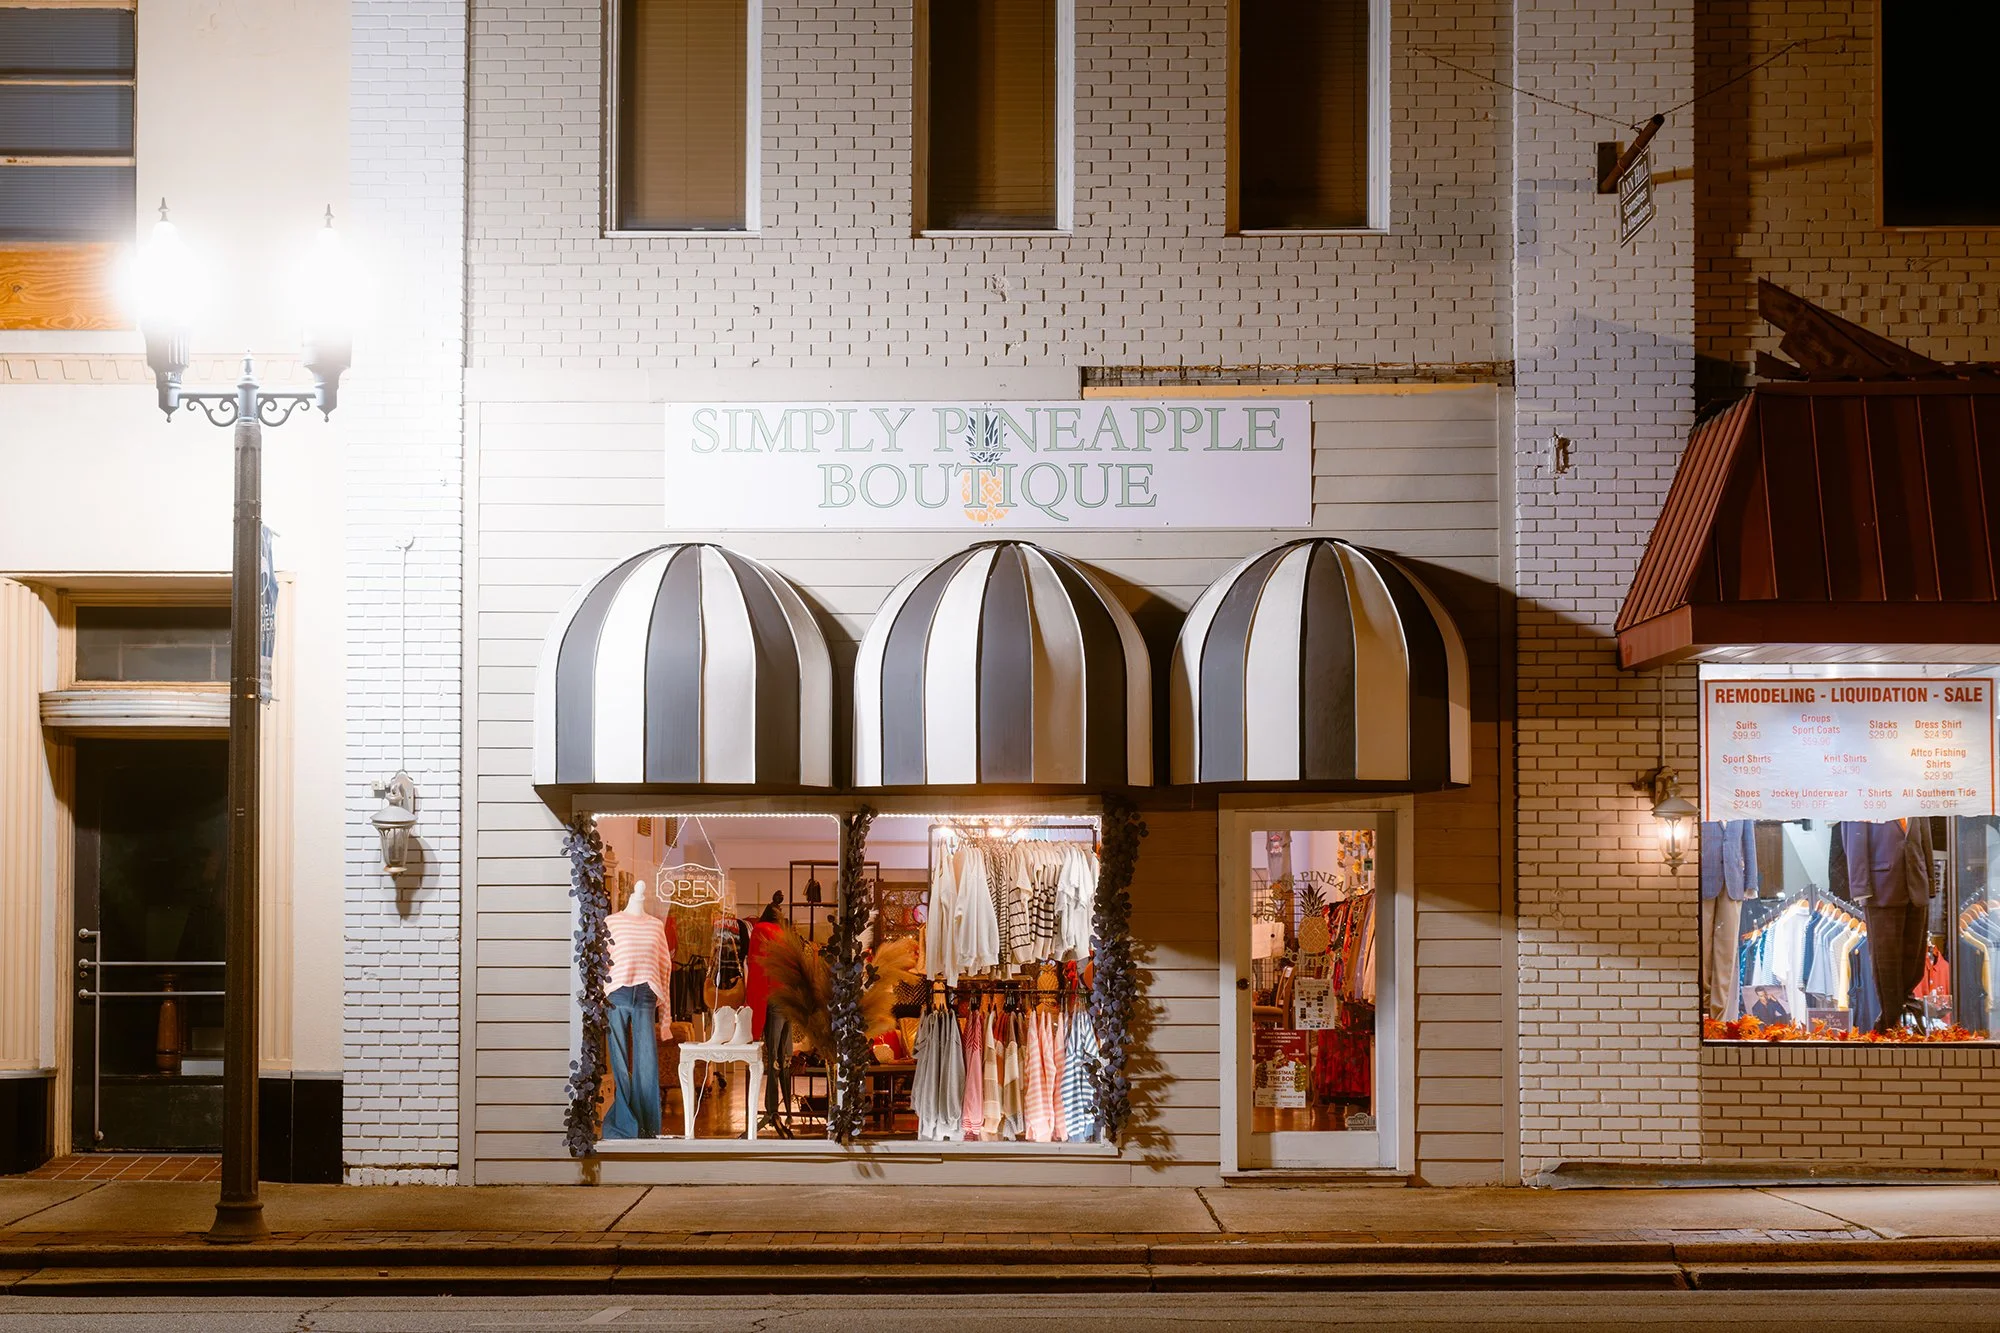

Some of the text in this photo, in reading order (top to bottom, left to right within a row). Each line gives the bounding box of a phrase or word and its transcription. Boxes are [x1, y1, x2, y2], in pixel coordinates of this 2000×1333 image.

[690, 405, 1285, 453] SIMPLY PINEAPPLE
[817, 462, 1158, 522] BOUTIQUE
[1715, 687, 1815, 703] REMODELING
[1831, 687, 1928, 704] LIQUIDATION
[1944, 686, 1983, 703] SALE
[1801, 713, 1831, 723] Groups
[1736, 720, 1758, 730] Suits
[1869, 720, 1898, 729] Slacks
[1915, 720, 1962, 729] Dress Shirt
[1792, 725, 1841, 736] Sport Coats
[1935, 748, 1966, 758] Fishing
[1722, 754, 1772, 764] Sport Shirts
[1824, 754, 1867, 763] Knit Shirts
[1926, 760, 1951, 769] Shirts
[1734, 789, 1760, 798] Shoes
[1771, 789, 1848, 799] Jockey Underwear
[1868, 788, 1892, 797] Shirts
[1902, 788, 1977, 797] All Southern Tide
[659, 879, 721, 897] OPEN
